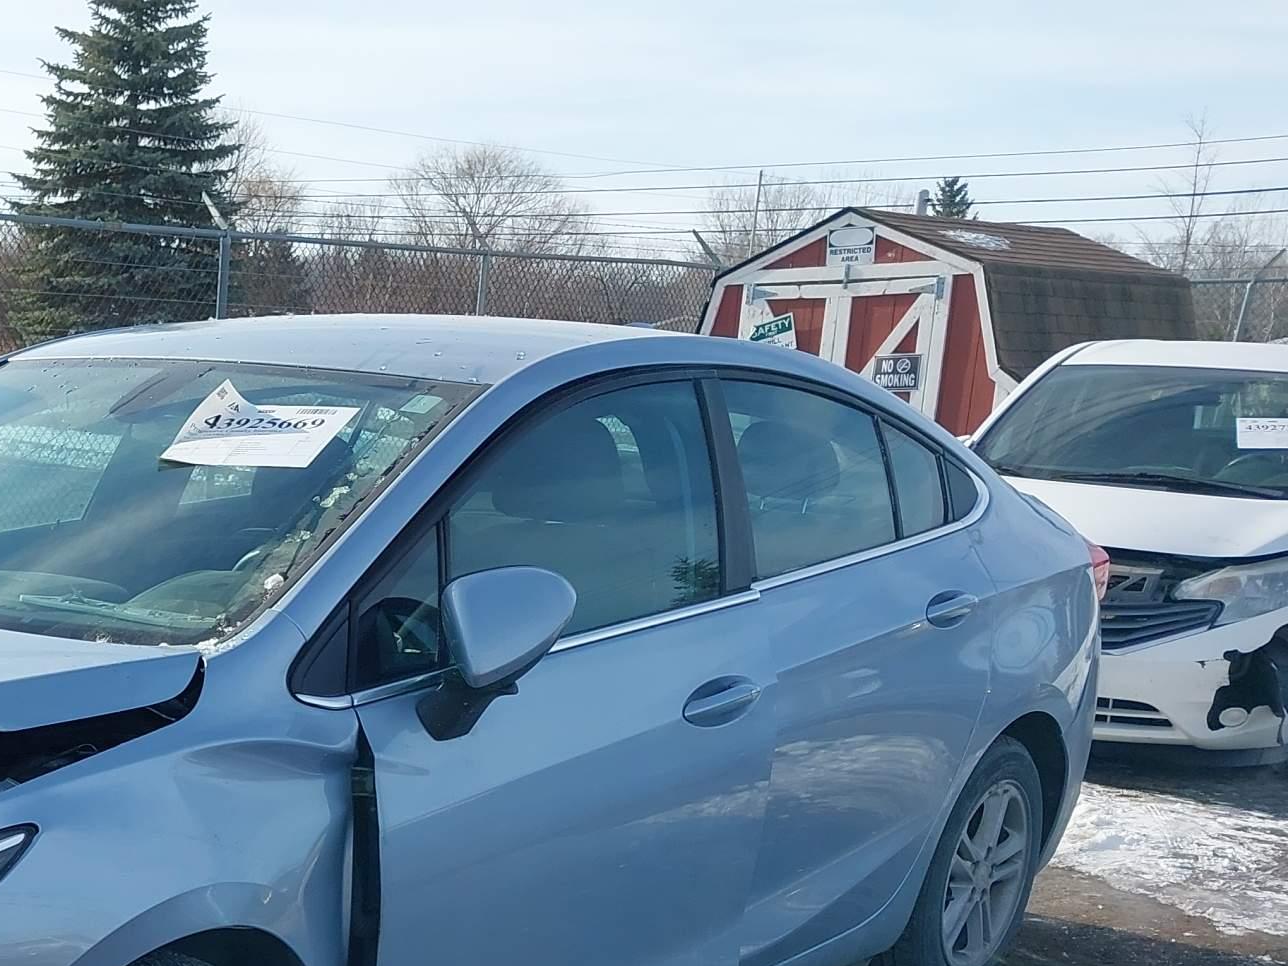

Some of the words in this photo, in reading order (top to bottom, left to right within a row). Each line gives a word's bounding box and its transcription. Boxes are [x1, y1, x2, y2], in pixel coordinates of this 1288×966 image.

[829, 246, 872, 256] RESTRICTED
[882, 359, 894, 373] NO
[875, 373, 916, 387] SMOKING
[204, 413, 326, 430] 43925669
